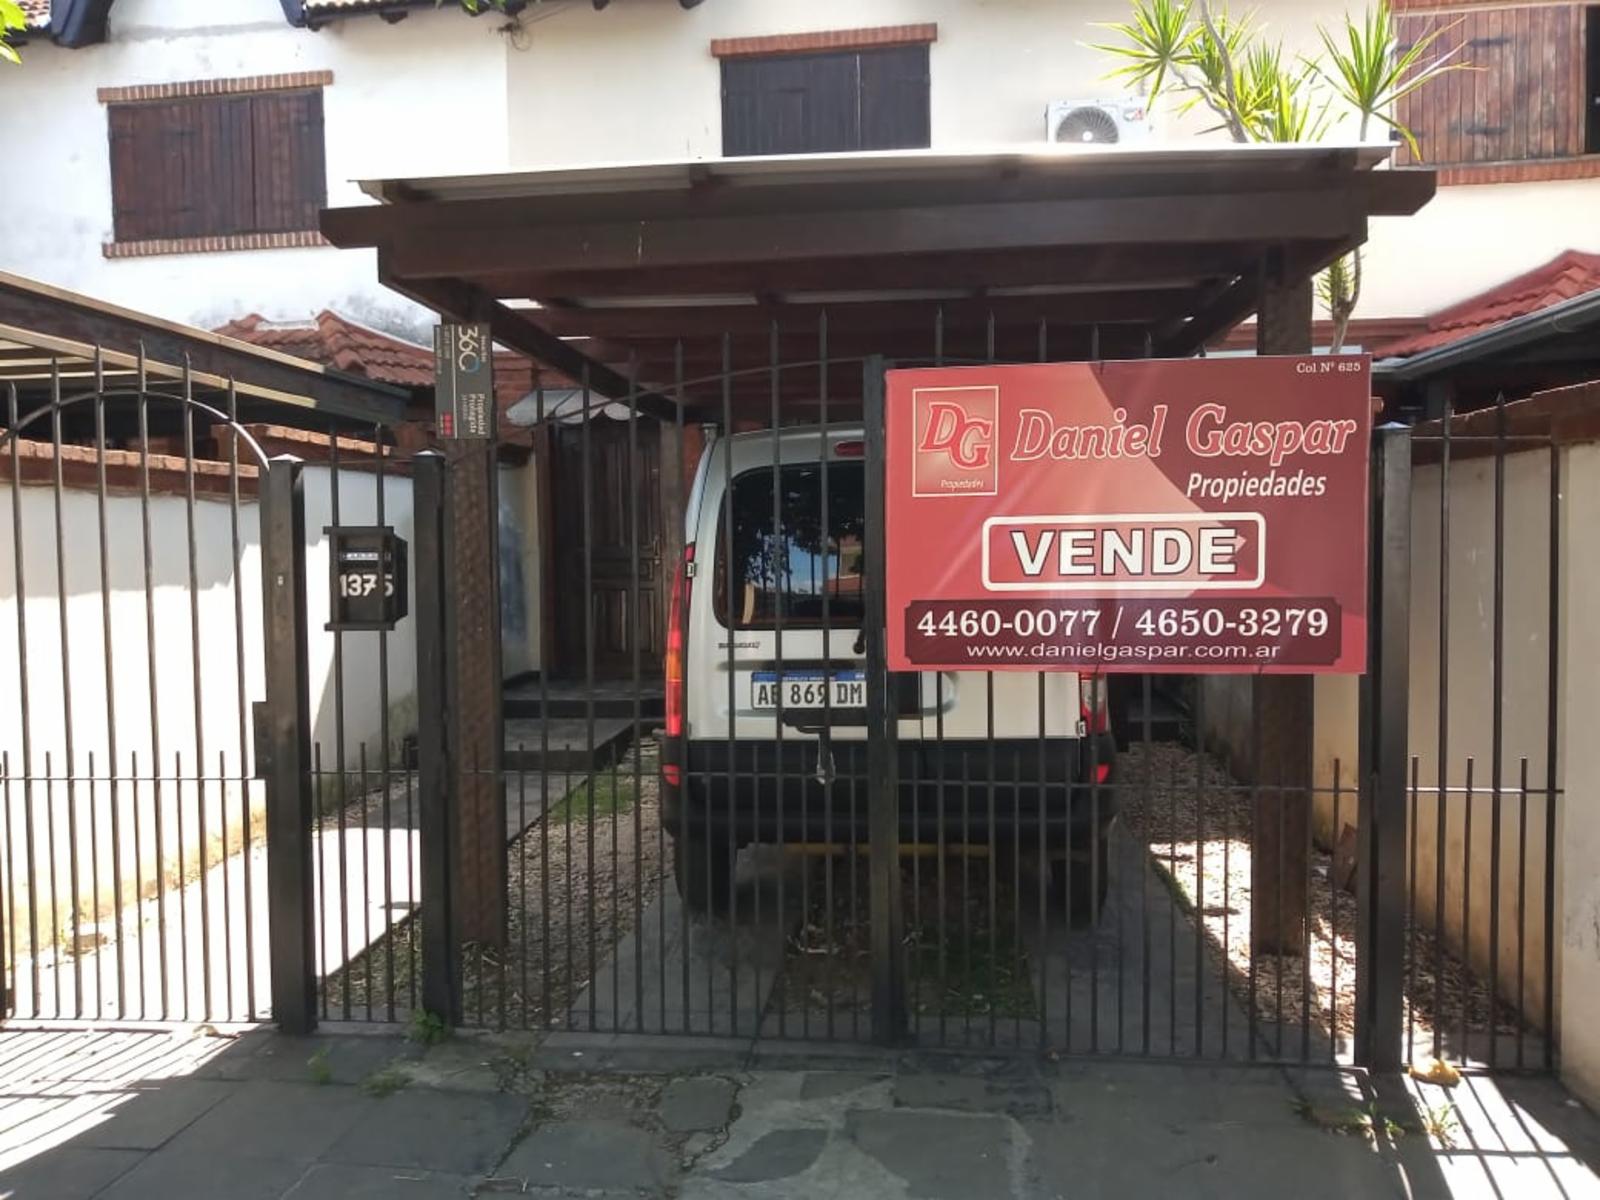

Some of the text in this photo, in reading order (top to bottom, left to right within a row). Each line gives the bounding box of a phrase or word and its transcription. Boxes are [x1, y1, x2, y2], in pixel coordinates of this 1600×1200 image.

[1296, 362, 1316, 374] Col
[918, 401, 993, 470] DG
[1010, 402, 1357, 467] Daniel Gaspar
[1186, 469, 1327, 503] Propiedades
[1010, 527, 1238, 576] VENDE
[916, 606, 1329, 640] 4460-0077 / 4650-3279
[966, 642, 1281, 661] www.danielgaspar.com.ar
[836, 683, 863, 705] DM
